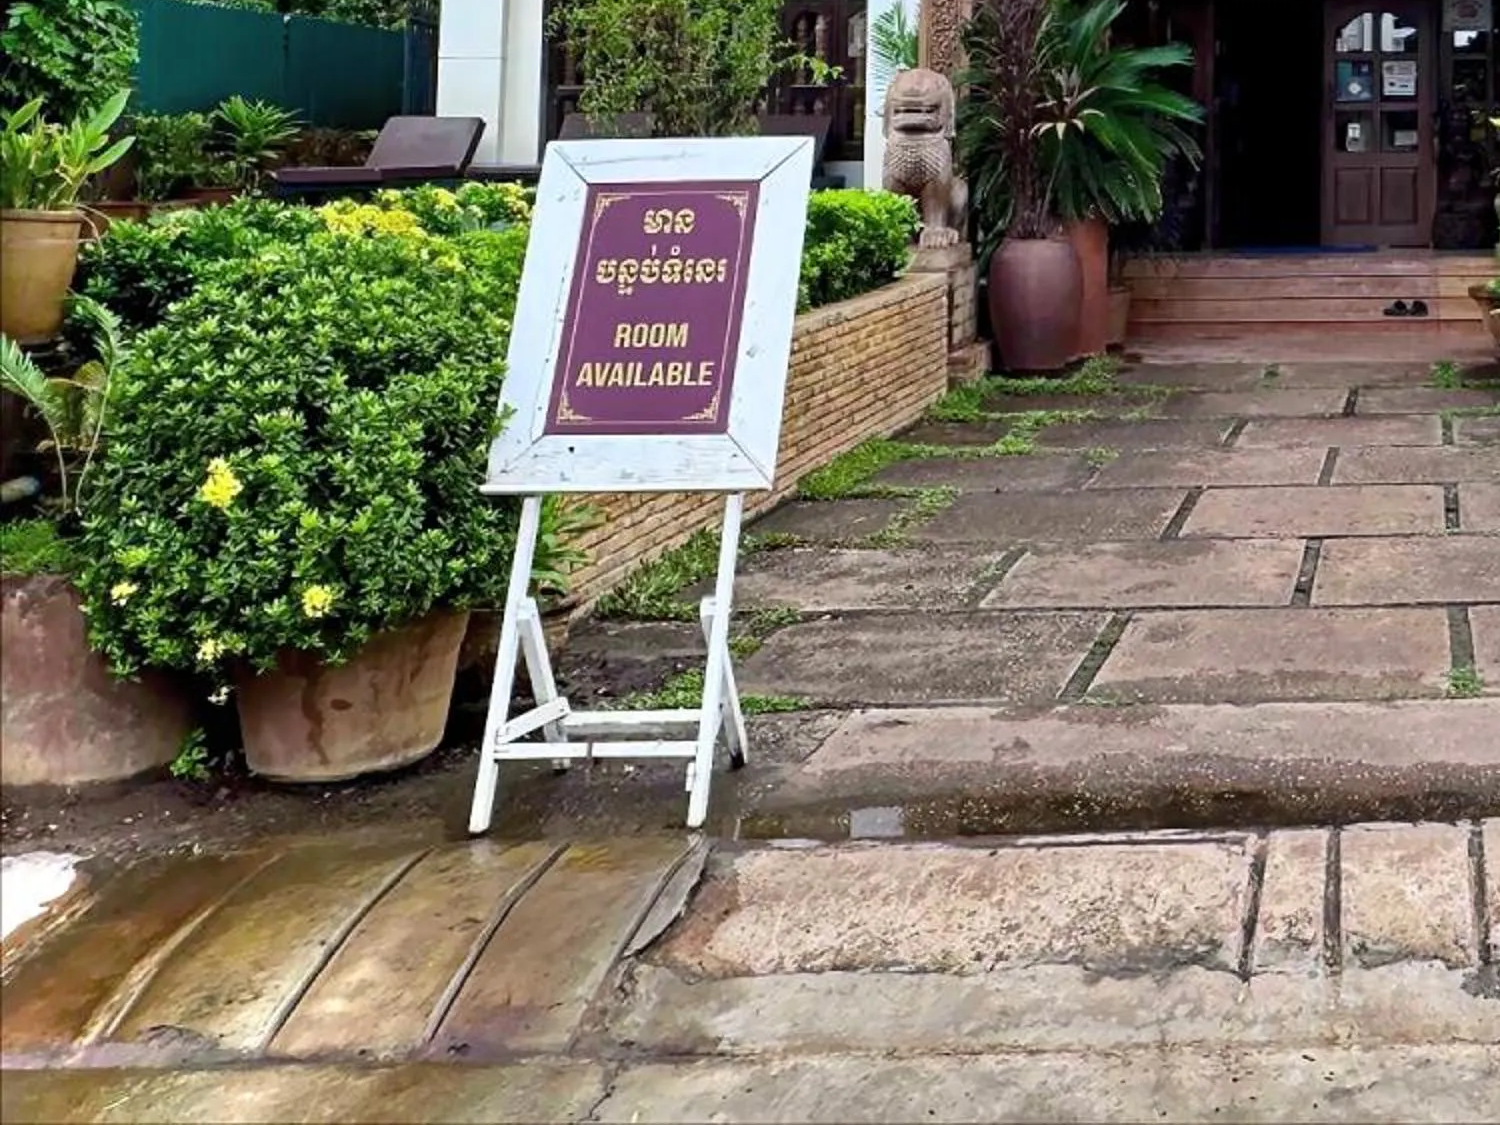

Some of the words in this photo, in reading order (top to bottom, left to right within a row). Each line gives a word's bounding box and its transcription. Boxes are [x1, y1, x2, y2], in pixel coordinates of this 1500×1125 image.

[643, 207, 696, 234] មាន
[595, 244, 728, 296] បន្ទប់ទំនេរ
[613, 322, 689, 348] ROOM
[576, 361, 715, 386] AVAILABLE
